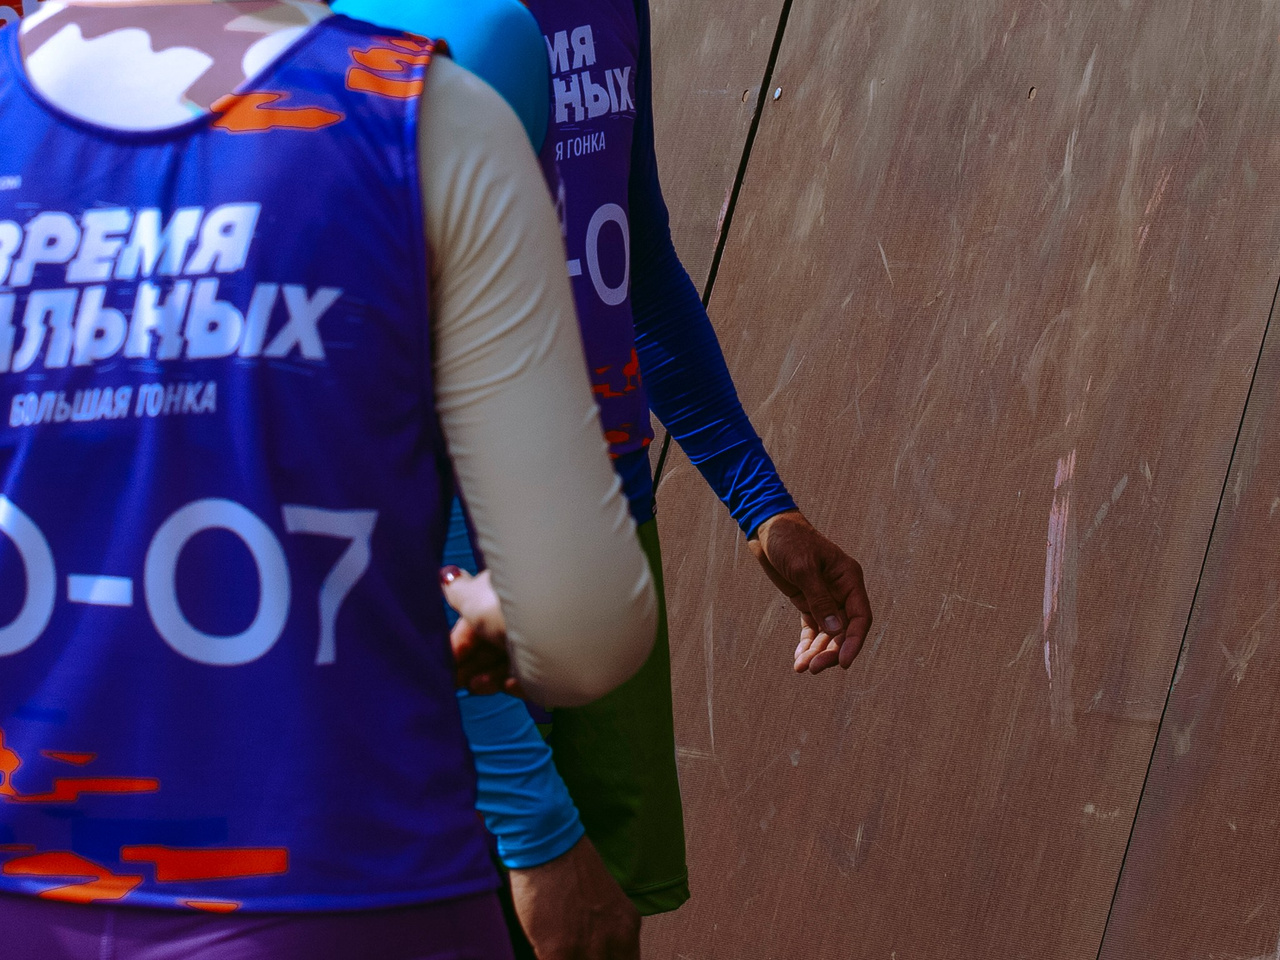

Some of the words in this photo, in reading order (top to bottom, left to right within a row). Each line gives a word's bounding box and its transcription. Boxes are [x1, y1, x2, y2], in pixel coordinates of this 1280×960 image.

[567, 131, 606, 159] ГОНКА
[562, 203, 630, 306] -0
[9, 386, 133, 427] БОЛЬШАЯ
[135, 381, 216, 418] ГОНКА
